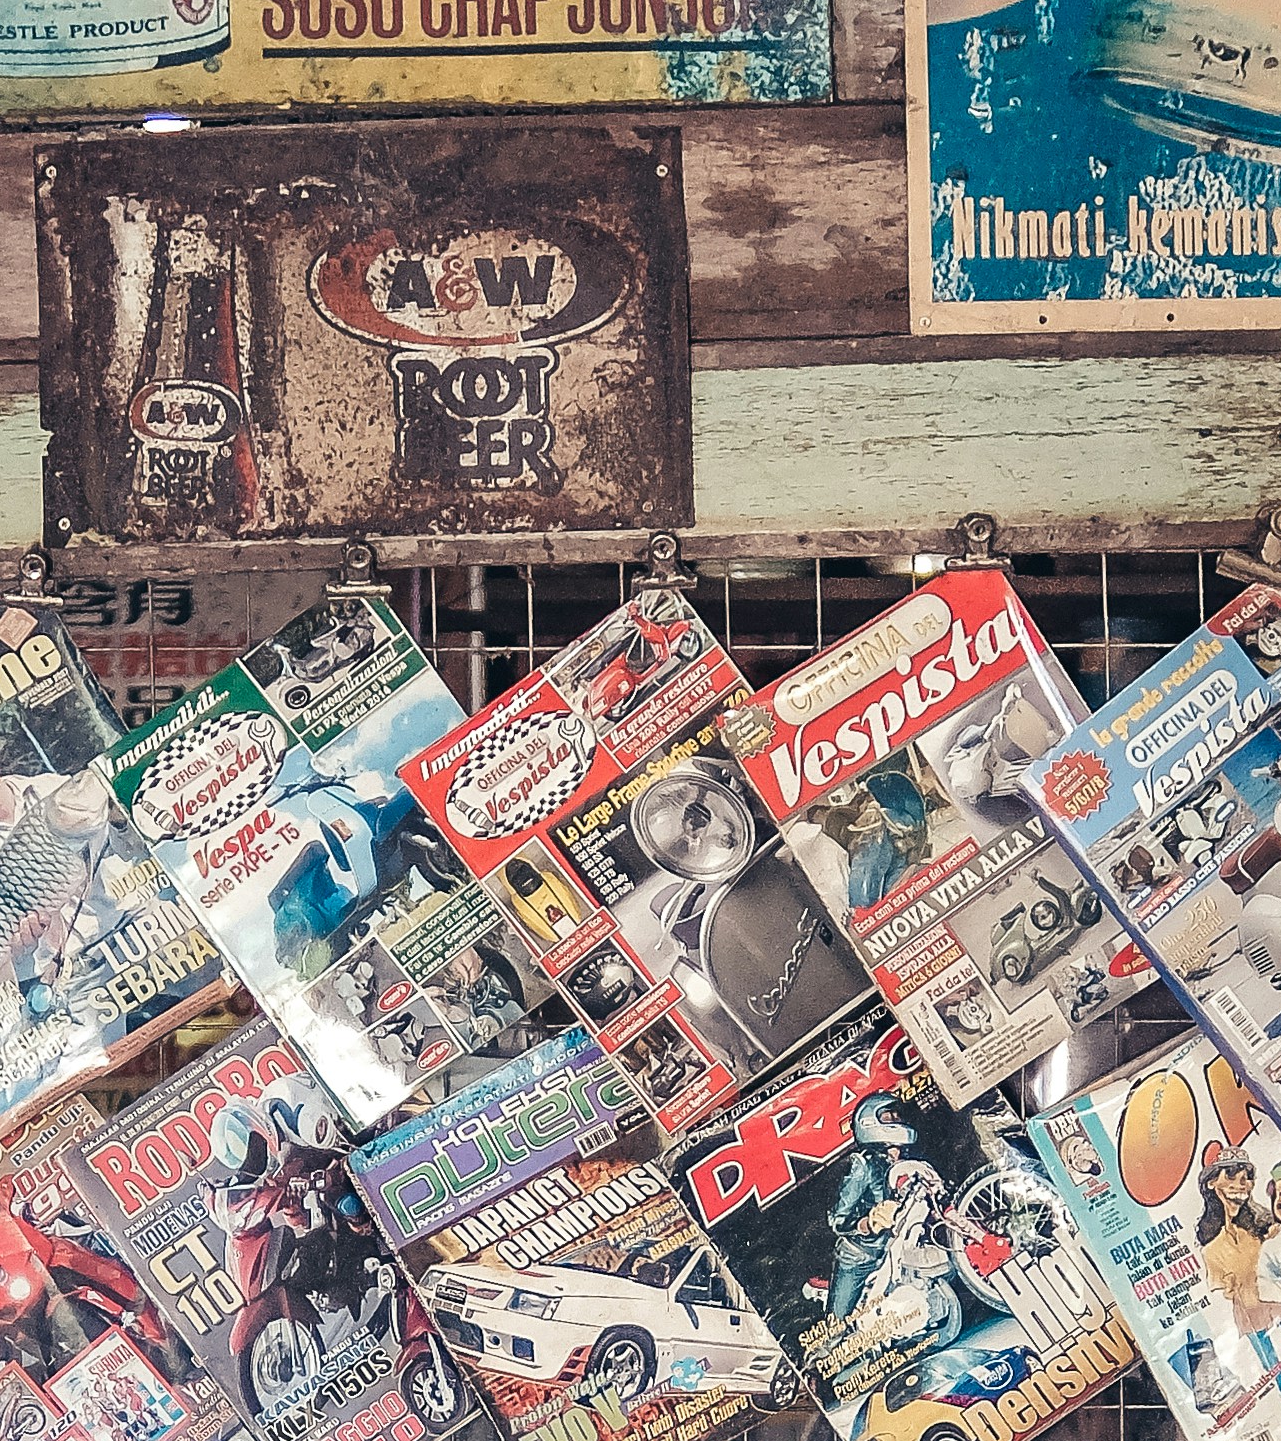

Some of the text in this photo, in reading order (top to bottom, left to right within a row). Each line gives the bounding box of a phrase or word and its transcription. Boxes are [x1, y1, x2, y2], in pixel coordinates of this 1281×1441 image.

[68, 15, 168, 37] PRODUCT
[387, 255, 555, 315] A&W
[147, 399, 221, 426] A&W
[401, 357, 549, 417] ROOT
[770, 607, 1025, 809] Vespista
[1127, 673, 1235, 767] OFFICINA DEL
[213, 735, 237, 759] DEL
[523, 734, 549, 760] DEL
[1131, 686, 1271, 818] Vespista
[171, 745, 262, 827] Vespista
[478, 738, 581, 824] Vespista
[191, 805, 282, 880] Vespa
[556, 795, 616, 848] Le Large
[199, 877, 237, 911] serie
[860, 831, 1027, 961] NUOVA VITA ALLA
[925, 980, 946, 1002] Fai
[131, 1193, 211, 1259] MODENAS
[1110, 1218, 1184, 1265] BUTA MATA
[146, 1226, 219, 1296] CT
[1133, 1255, 1202, 1304] BUTA HATI
[177, 1269, 243, 1335] 110
[255, 1333, 377, 1426] KAWASAKI
